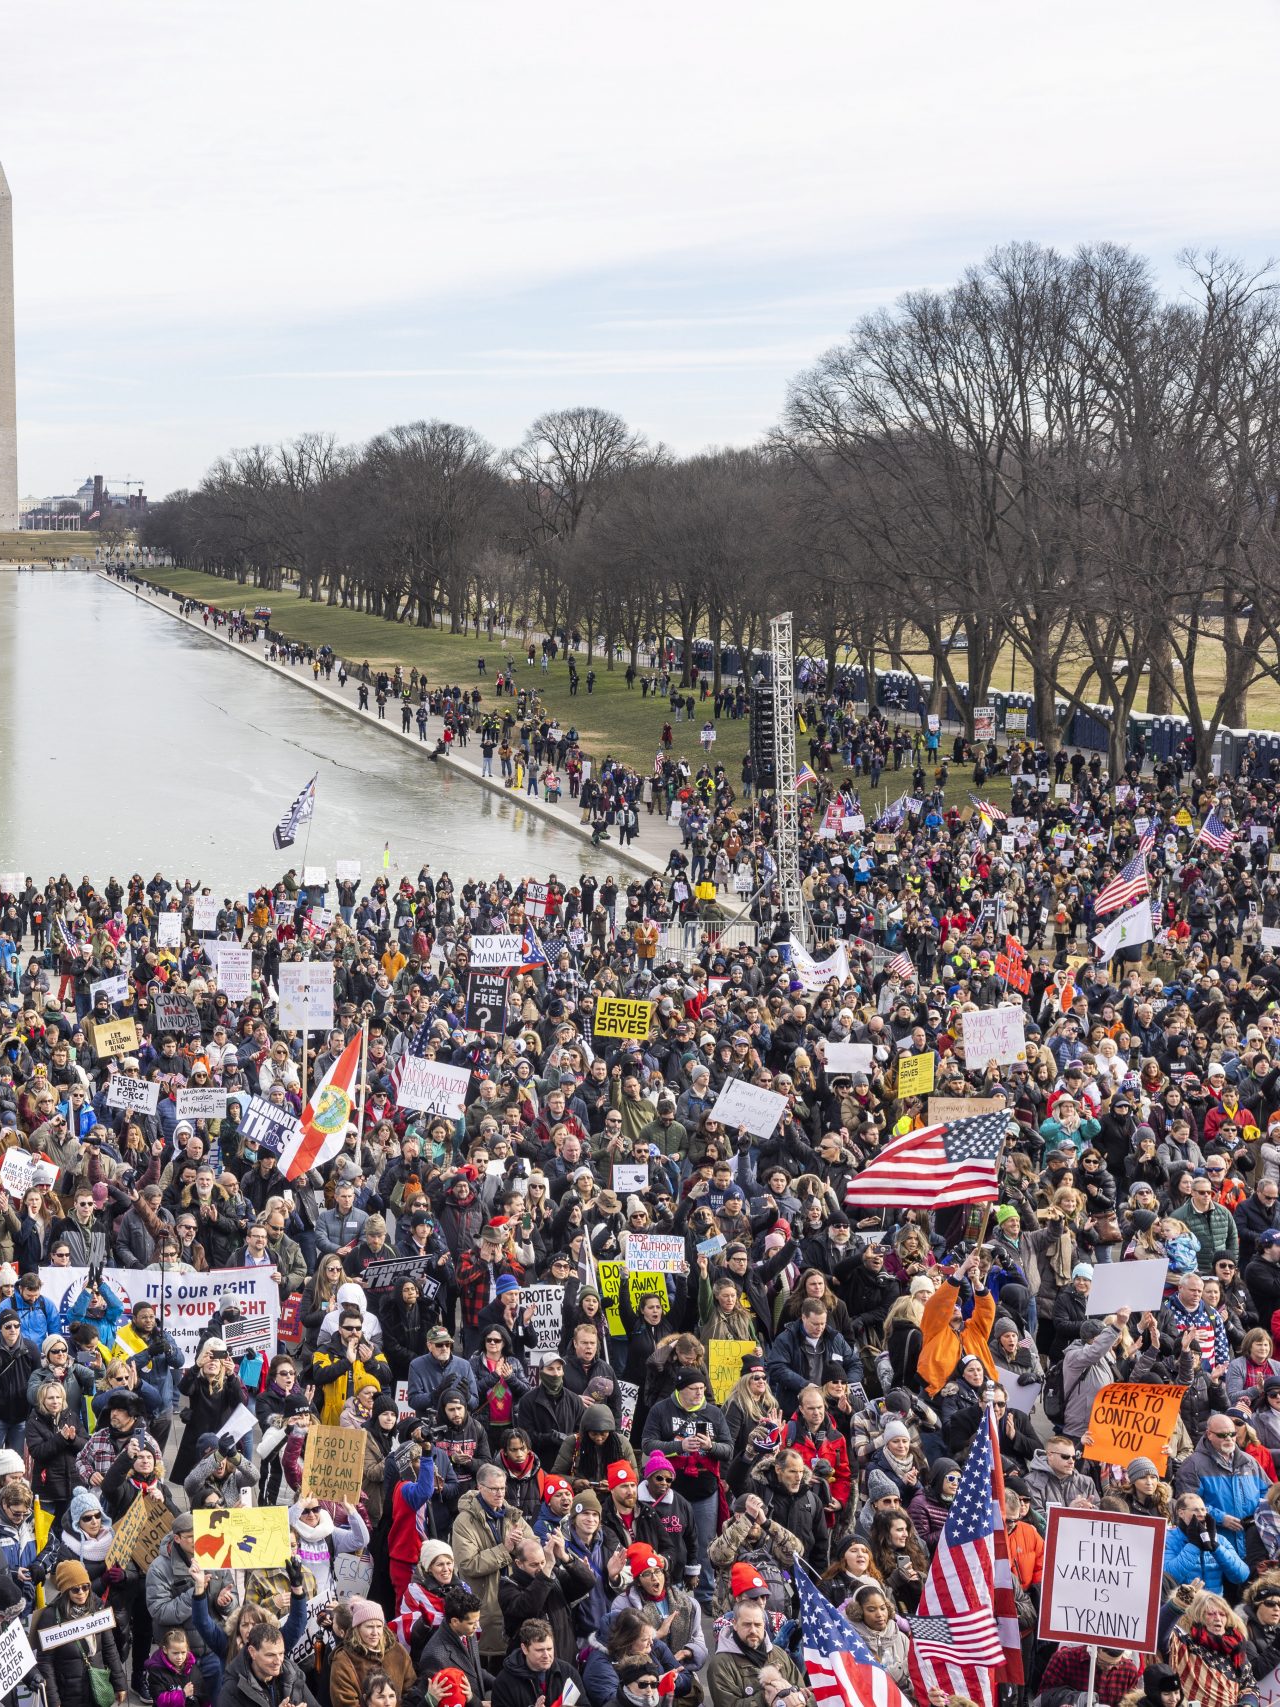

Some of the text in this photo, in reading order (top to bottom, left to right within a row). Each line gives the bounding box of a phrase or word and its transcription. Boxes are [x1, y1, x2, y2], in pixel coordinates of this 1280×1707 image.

[475, 938, 519, 948] NO VAX
[473, 952, 520, 963] MANDATE
[476, 975, 504, 986] LAND
[156, 995, 187, 1007] COVID
[473, 993, 502, 1006] FREE
[600, 1002, 648, 1019] JESUS
[160, 1015, 200, 1028] MANDATES
[476, 1007, 492, 1030] ?
[597, 1017, 647, 1034] SAVES
[105, 1036, 131, 1046] FREEDOM
[900, 1059, 918, 1069] JESUS
[900, 1068, 918, 1079] SAVES
[112, 1076, 149, 1089] FREEDOM
[402, 1070, 468, 1094] INDIVIDUALIZED
[401, 1082, 450, 1104] HEALTHCARE
[427, 1102, 448, 1115] ALL
[4, 1167, 22, 1177] PUBLIC
[640, 1242, 682, 1252] AUTHORITY
[366, 1259, 428, 1275] MANDATE
[629, 1261, 636, 1269] IN
[637, 1260, 657, 1270] EACH
[146, 1280, 256, 1299] IT'S OUR RIGHT
[632, 1277, 658, 1291] AWAY
[177, 1301, 215, 1315] YOUR
[549, 1319, 559, 1327] AN
[1139, 1385, 1183, 1399] CREATE
[1101, 1390, 1164, 1413] FEAR TO
[1094, 1406, 1167, 1438] CONTROL
[314, 1436, 360, 1451] IF GOD IS
[1111, 1428, 1144, 1452] YOU
[317, 1450, 355, 1463] FOR US
[311, 1464, 351, 1478] WHO CAN
[309, 1475, 360, 1492] BE AGAINST
[316, 1489, 336, 1498] US?
[148, 1504, 167, 1521] WILL
[142, 1522, 164, 1546] NOT
[1089, 1521, 1121, 1541] THE
[1078, 1540, 1137, 1567] FINAL
[1056, 1564, 1133, 1588] VARIANT
[1094, 1588, 1110, 1602] IS
[45, 1616, 110, 1642] FREEDOM SAFETY
[1058, 1606, 1140, 1640] TYRANNY
[2, 1646, 16, 1664] THE
[2, 1667, 22, 1691] GOOD
